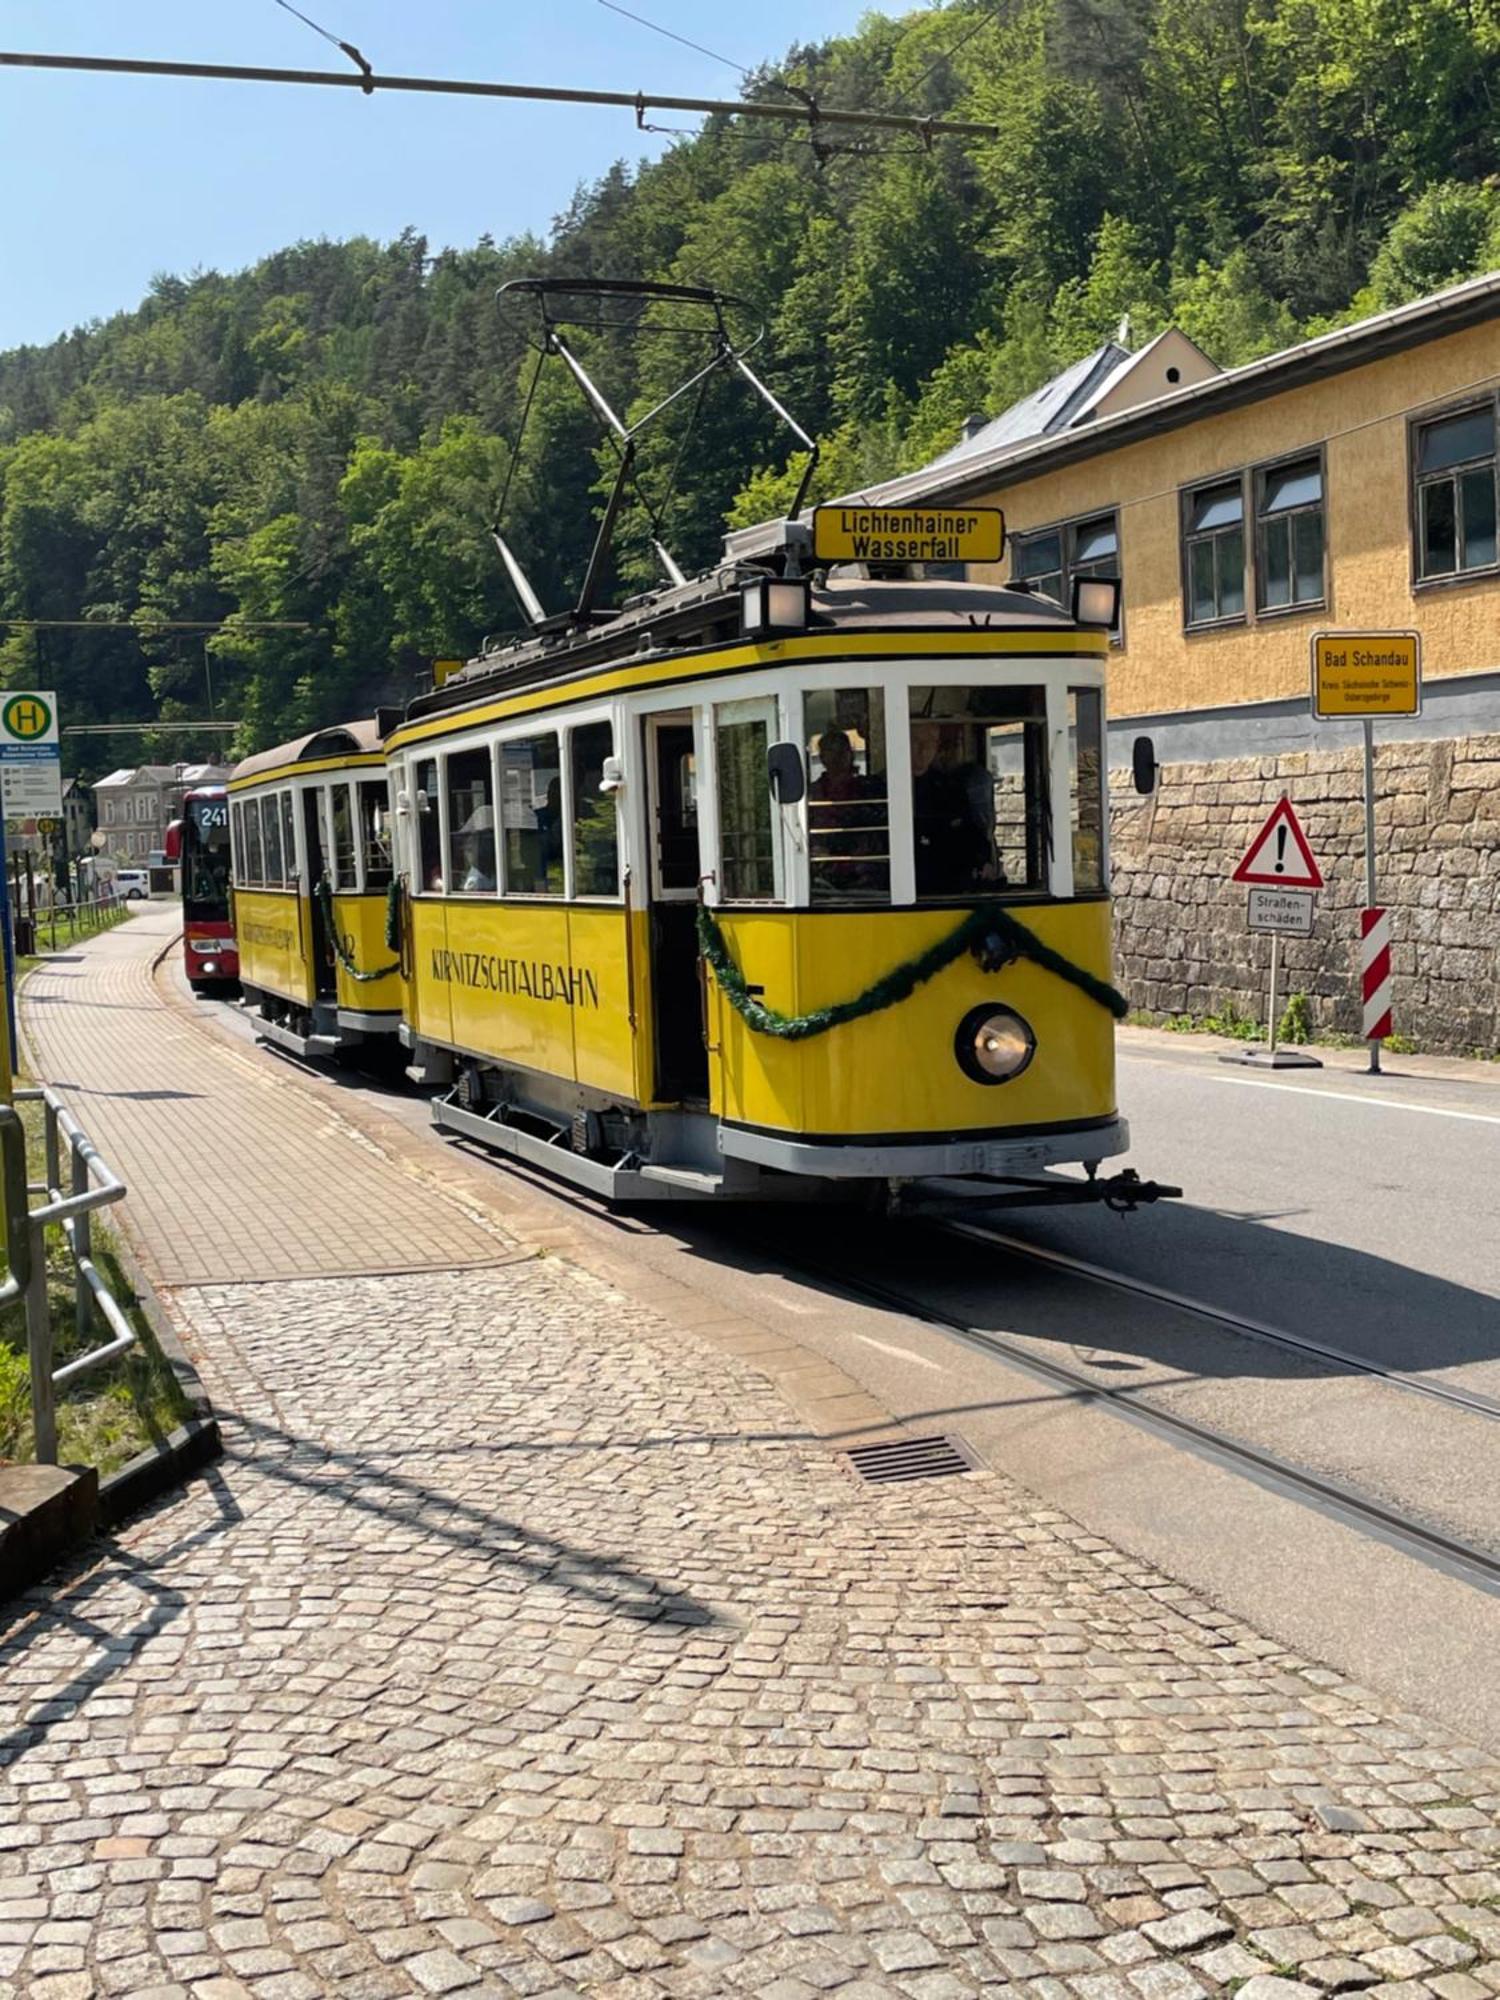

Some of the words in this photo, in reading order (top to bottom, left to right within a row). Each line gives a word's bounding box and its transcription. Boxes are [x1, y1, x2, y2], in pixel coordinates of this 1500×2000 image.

[842, 511, 978, 533] Lichtenhainer
[853, 536, 959, 558] Wasserfall
[1324, 650, 1347, 667] Bad
[1352, 650, 1409, 667] Schandau
[16, 703, 38, 731] H
[201, 807, 228, 827] 241
[1256, 895, 1306, 909] Straßen-
[1257, 912, 1304, 925] schäden
[431, 948, 599, 1010] KIRNITZSCHTALBAHN
